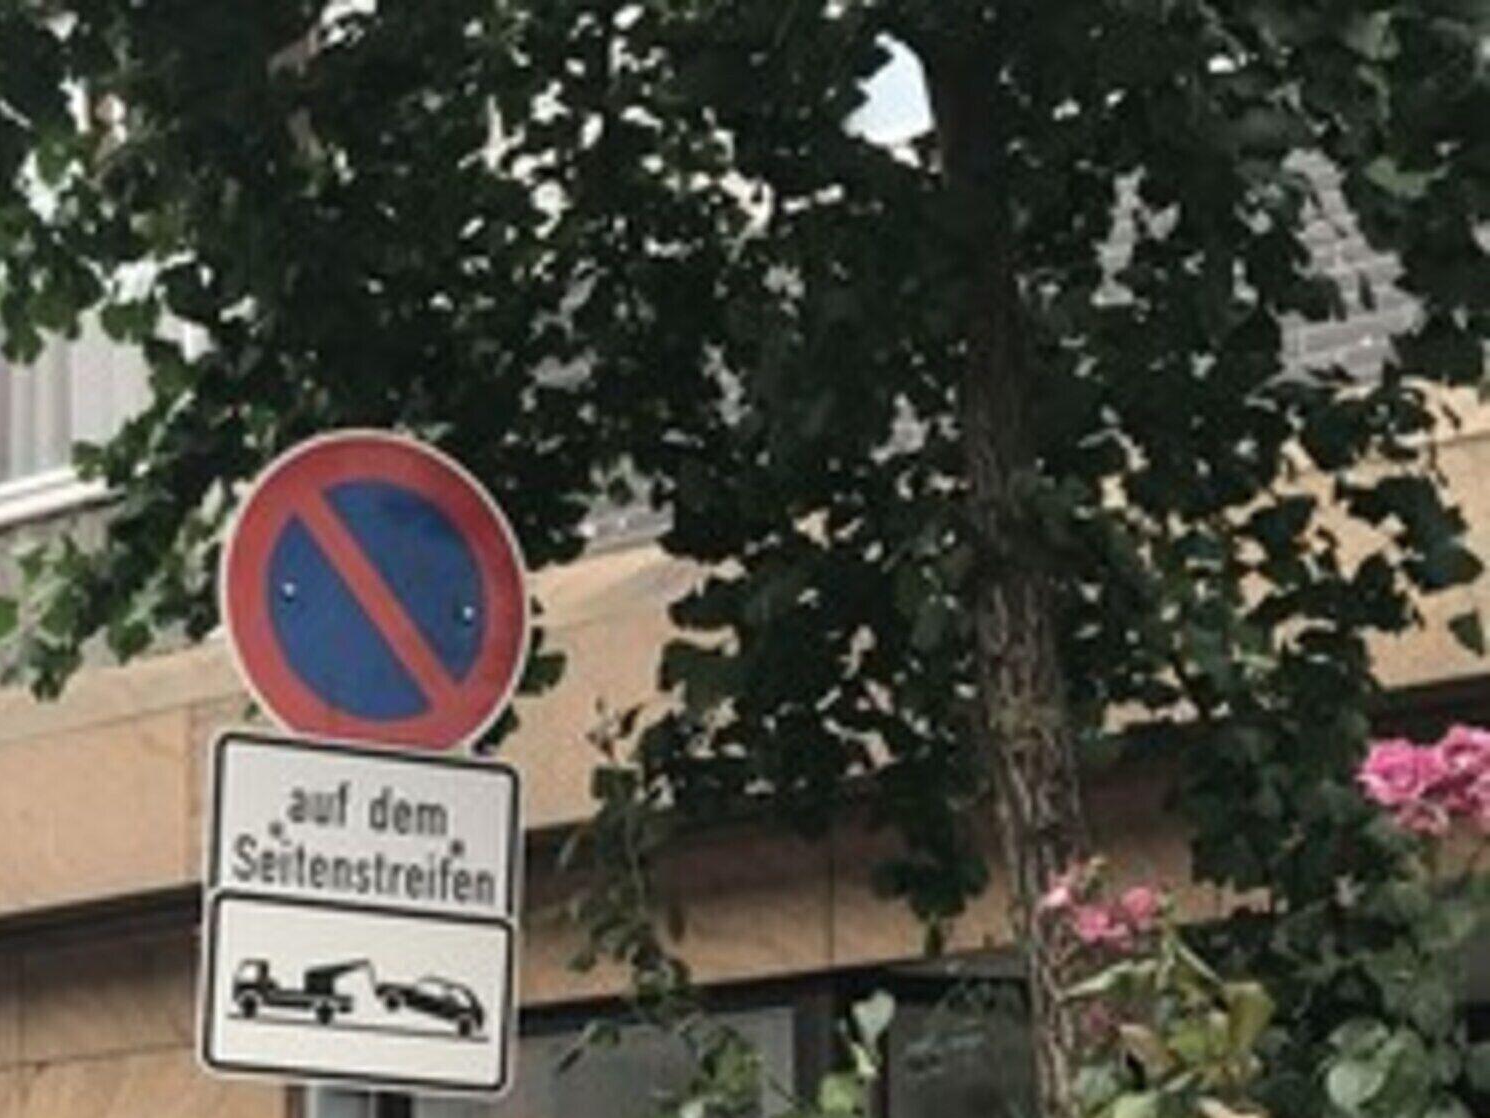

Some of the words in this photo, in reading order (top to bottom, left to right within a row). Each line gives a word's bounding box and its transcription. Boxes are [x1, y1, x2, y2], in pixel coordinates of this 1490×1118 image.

[287, 781, 350, 827] auf
[369, 786, 448, 835] dem
[232, 834, 495, 905] Seitenstreifen
